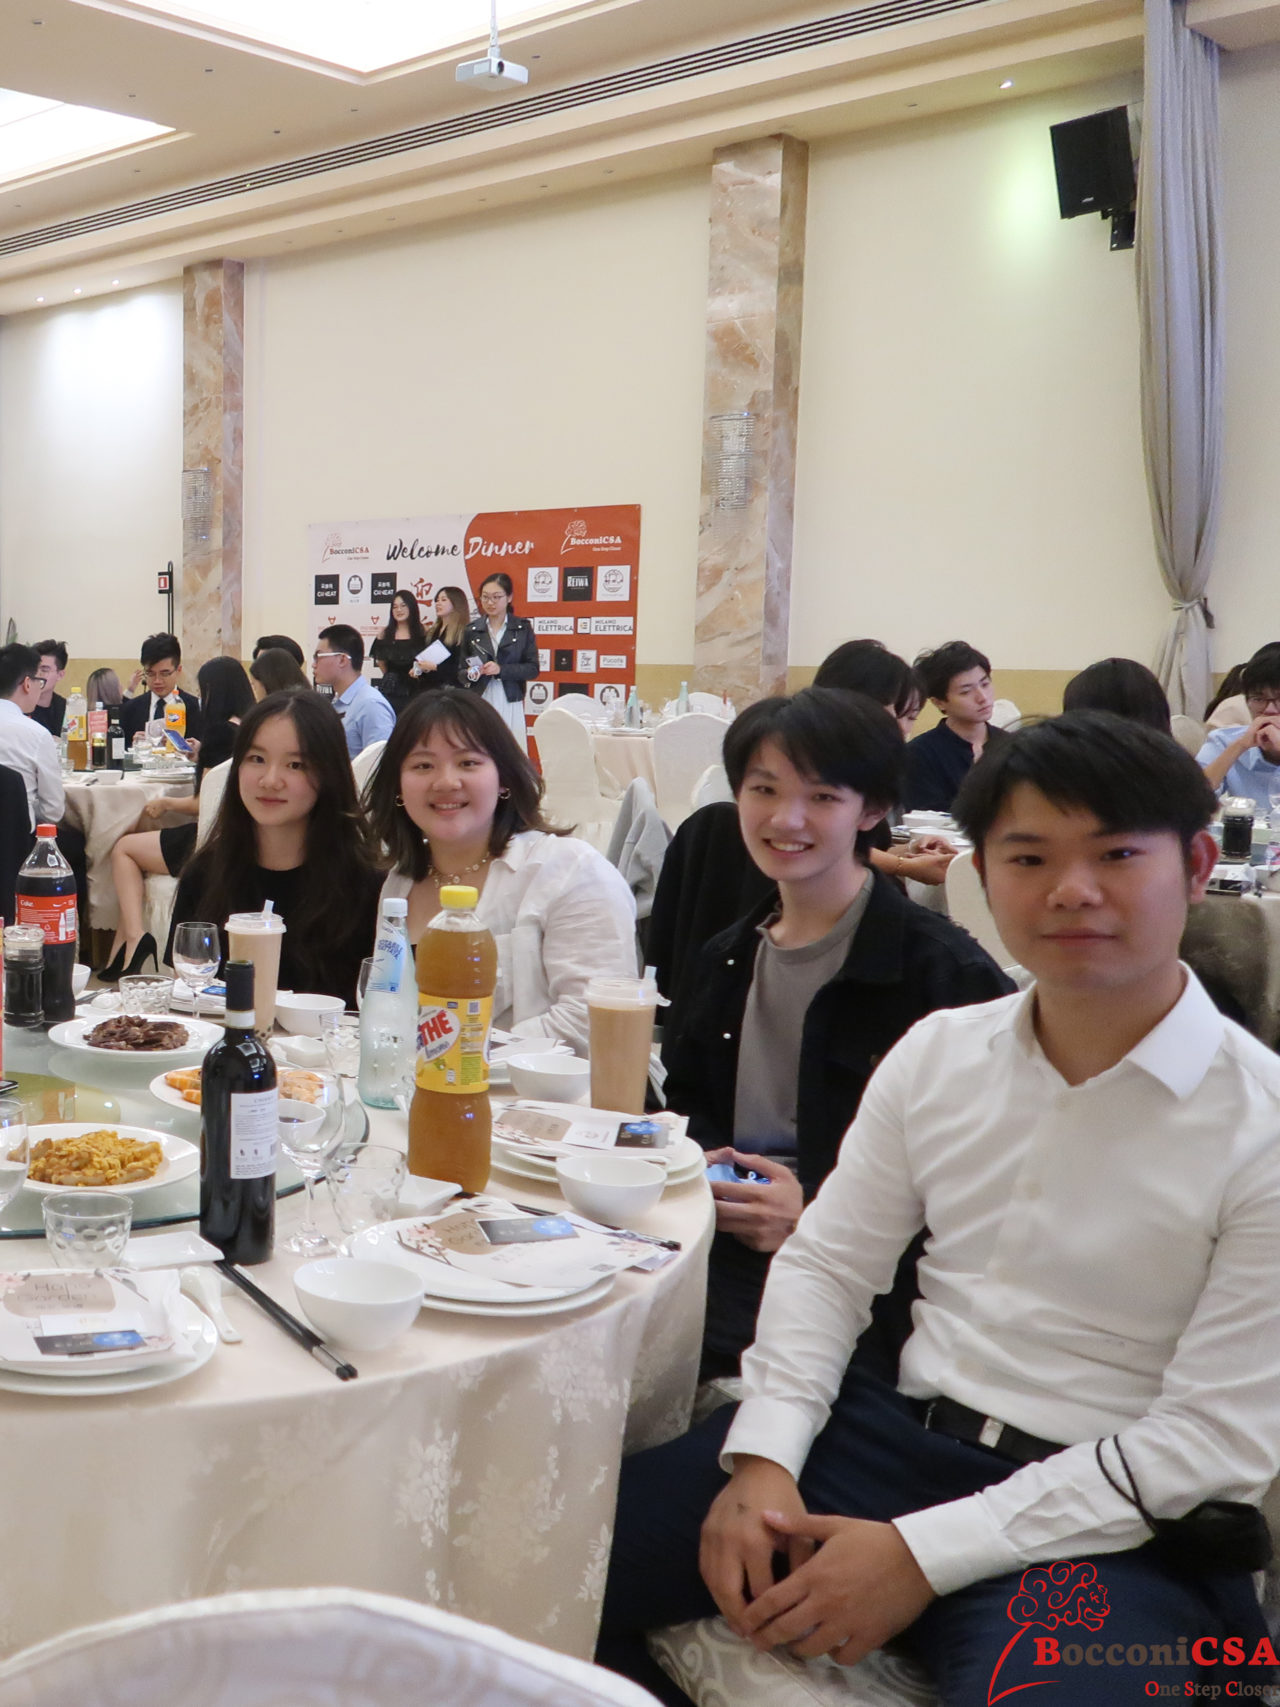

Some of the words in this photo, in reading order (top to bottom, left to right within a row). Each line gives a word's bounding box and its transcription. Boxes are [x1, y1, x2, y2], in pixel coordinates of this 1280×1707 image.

[386, 538, 461, 560] Welcome
[465, 536, 535, 560] Dinner
[538, 624, 574, 632] ELETTRICA
[595, 624, 633, 632] ELETTRICA
